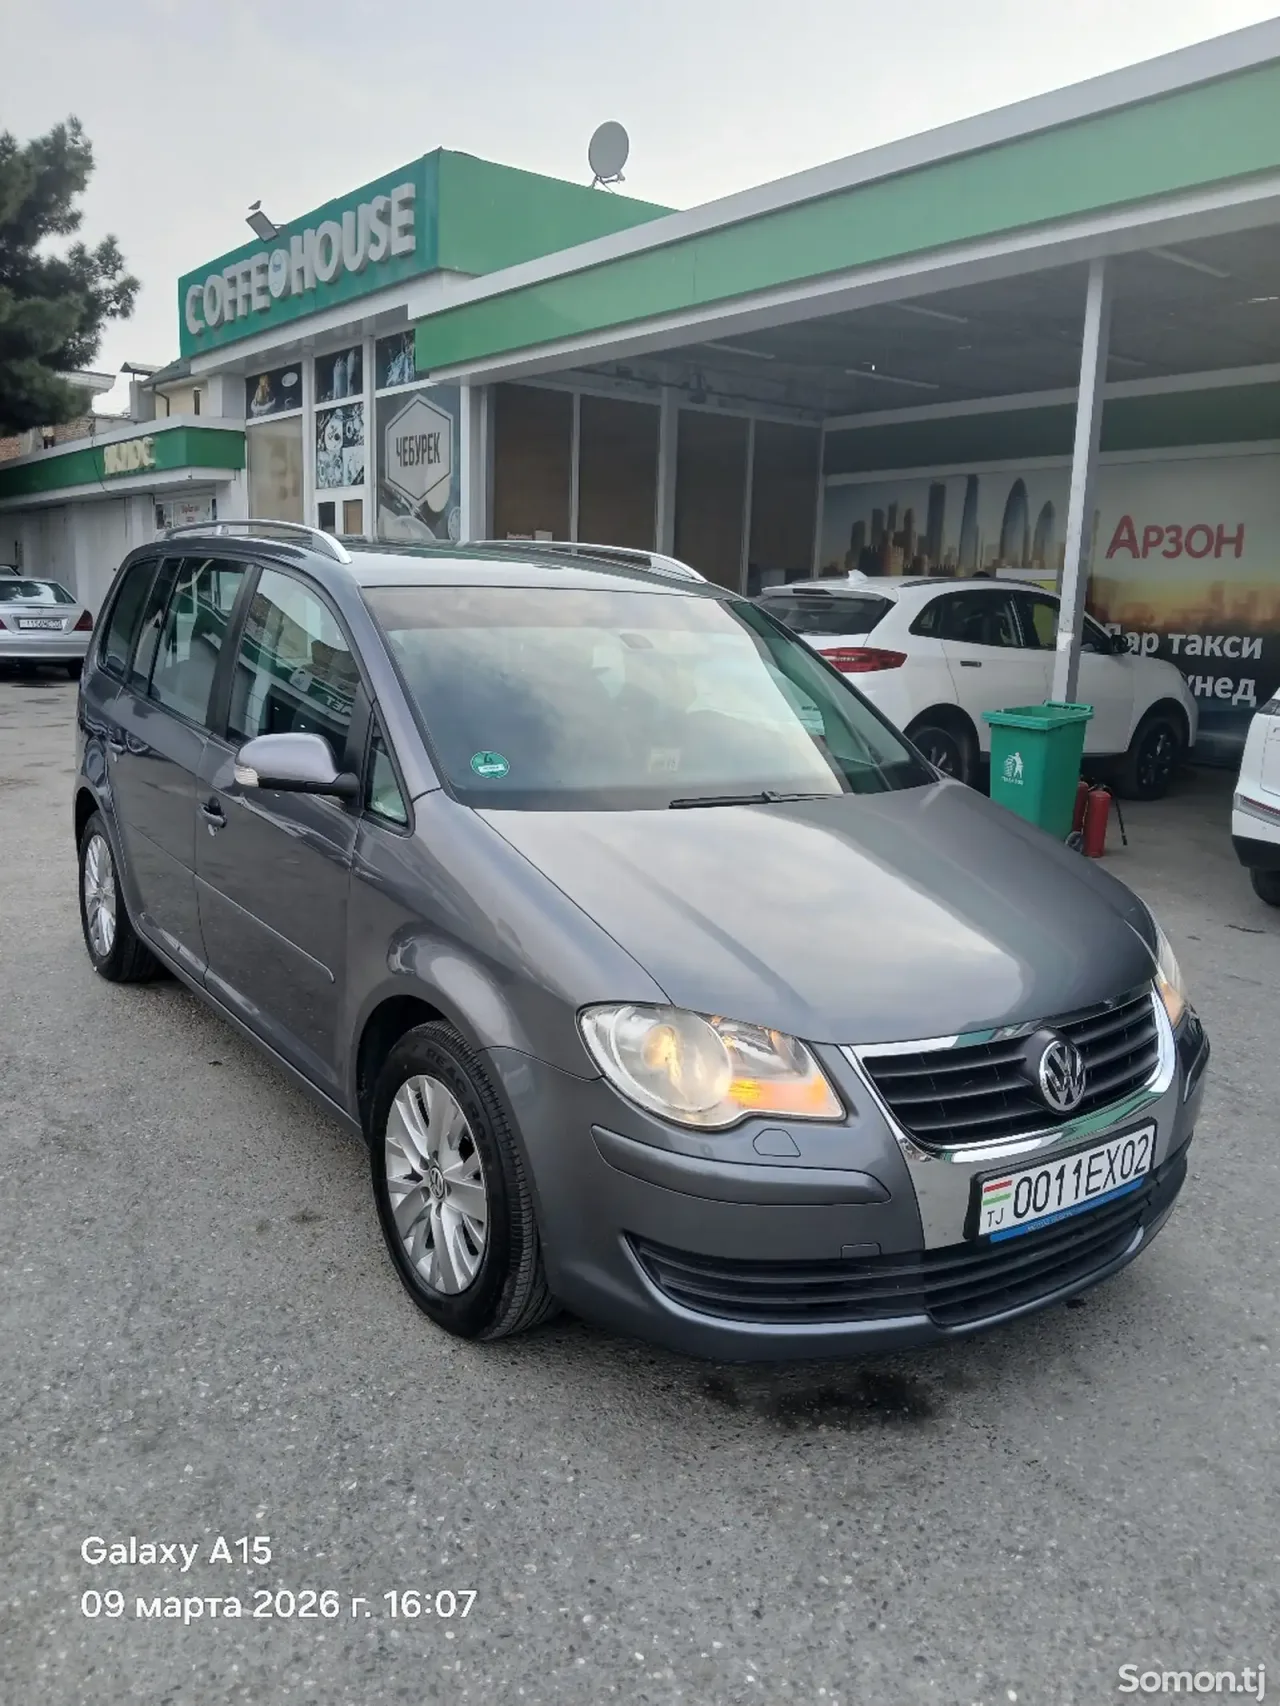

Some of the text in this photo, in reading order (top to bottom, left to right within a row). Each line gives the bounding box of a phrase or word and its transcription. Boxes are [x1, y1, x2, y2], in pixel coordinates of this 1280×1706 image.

[290, 183, 416, 294] HOUSE
[395, 431, 441, 468] ЧЕБУРЕК
[1167, 633, 1263, 660] такси
[1013, 1133, 1149, 1219] 0011EX02
[987, 1207, 1005, 1228] TJ
